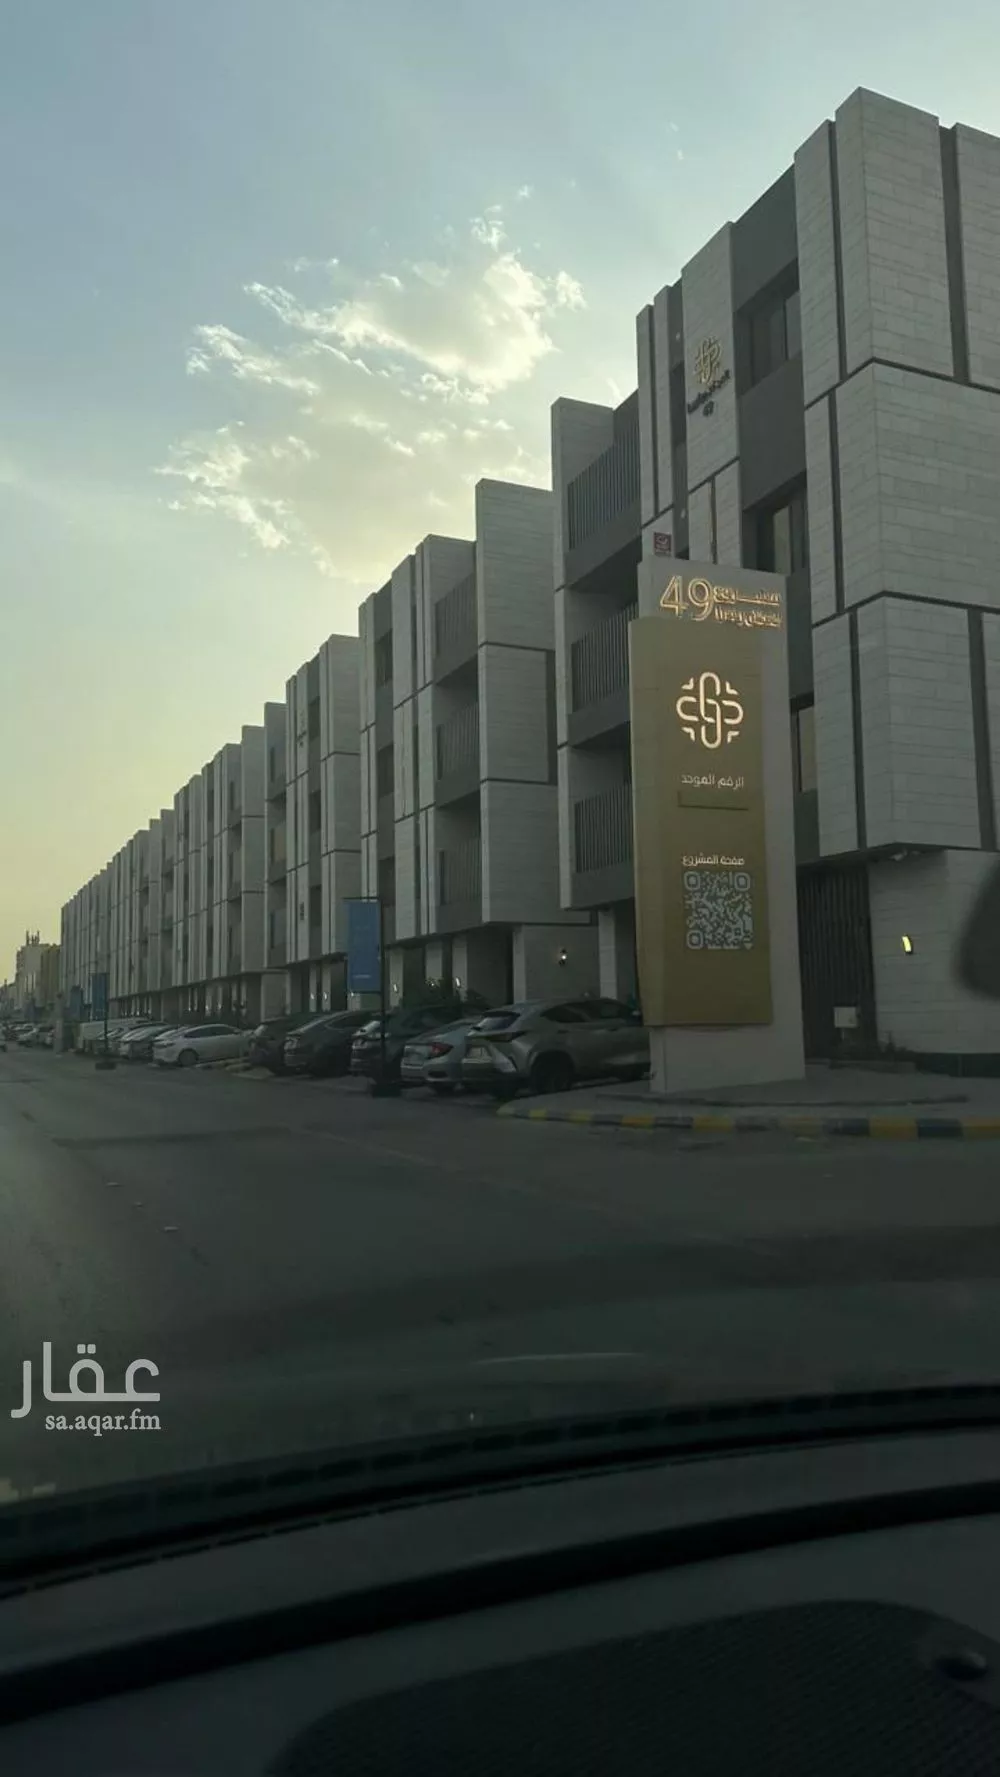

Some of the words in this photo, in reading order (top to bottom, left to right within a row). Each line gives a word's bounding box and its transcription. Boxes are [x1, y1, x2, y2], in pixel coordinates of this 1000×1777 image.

[660, 575, 714, 621] 49
[681, 773, 715, 787] الموحد
[717, 775, 745, 790] الرقم
[682, 852, 719, 867] المشروع
[720, 855, 745, 866] صفحة
